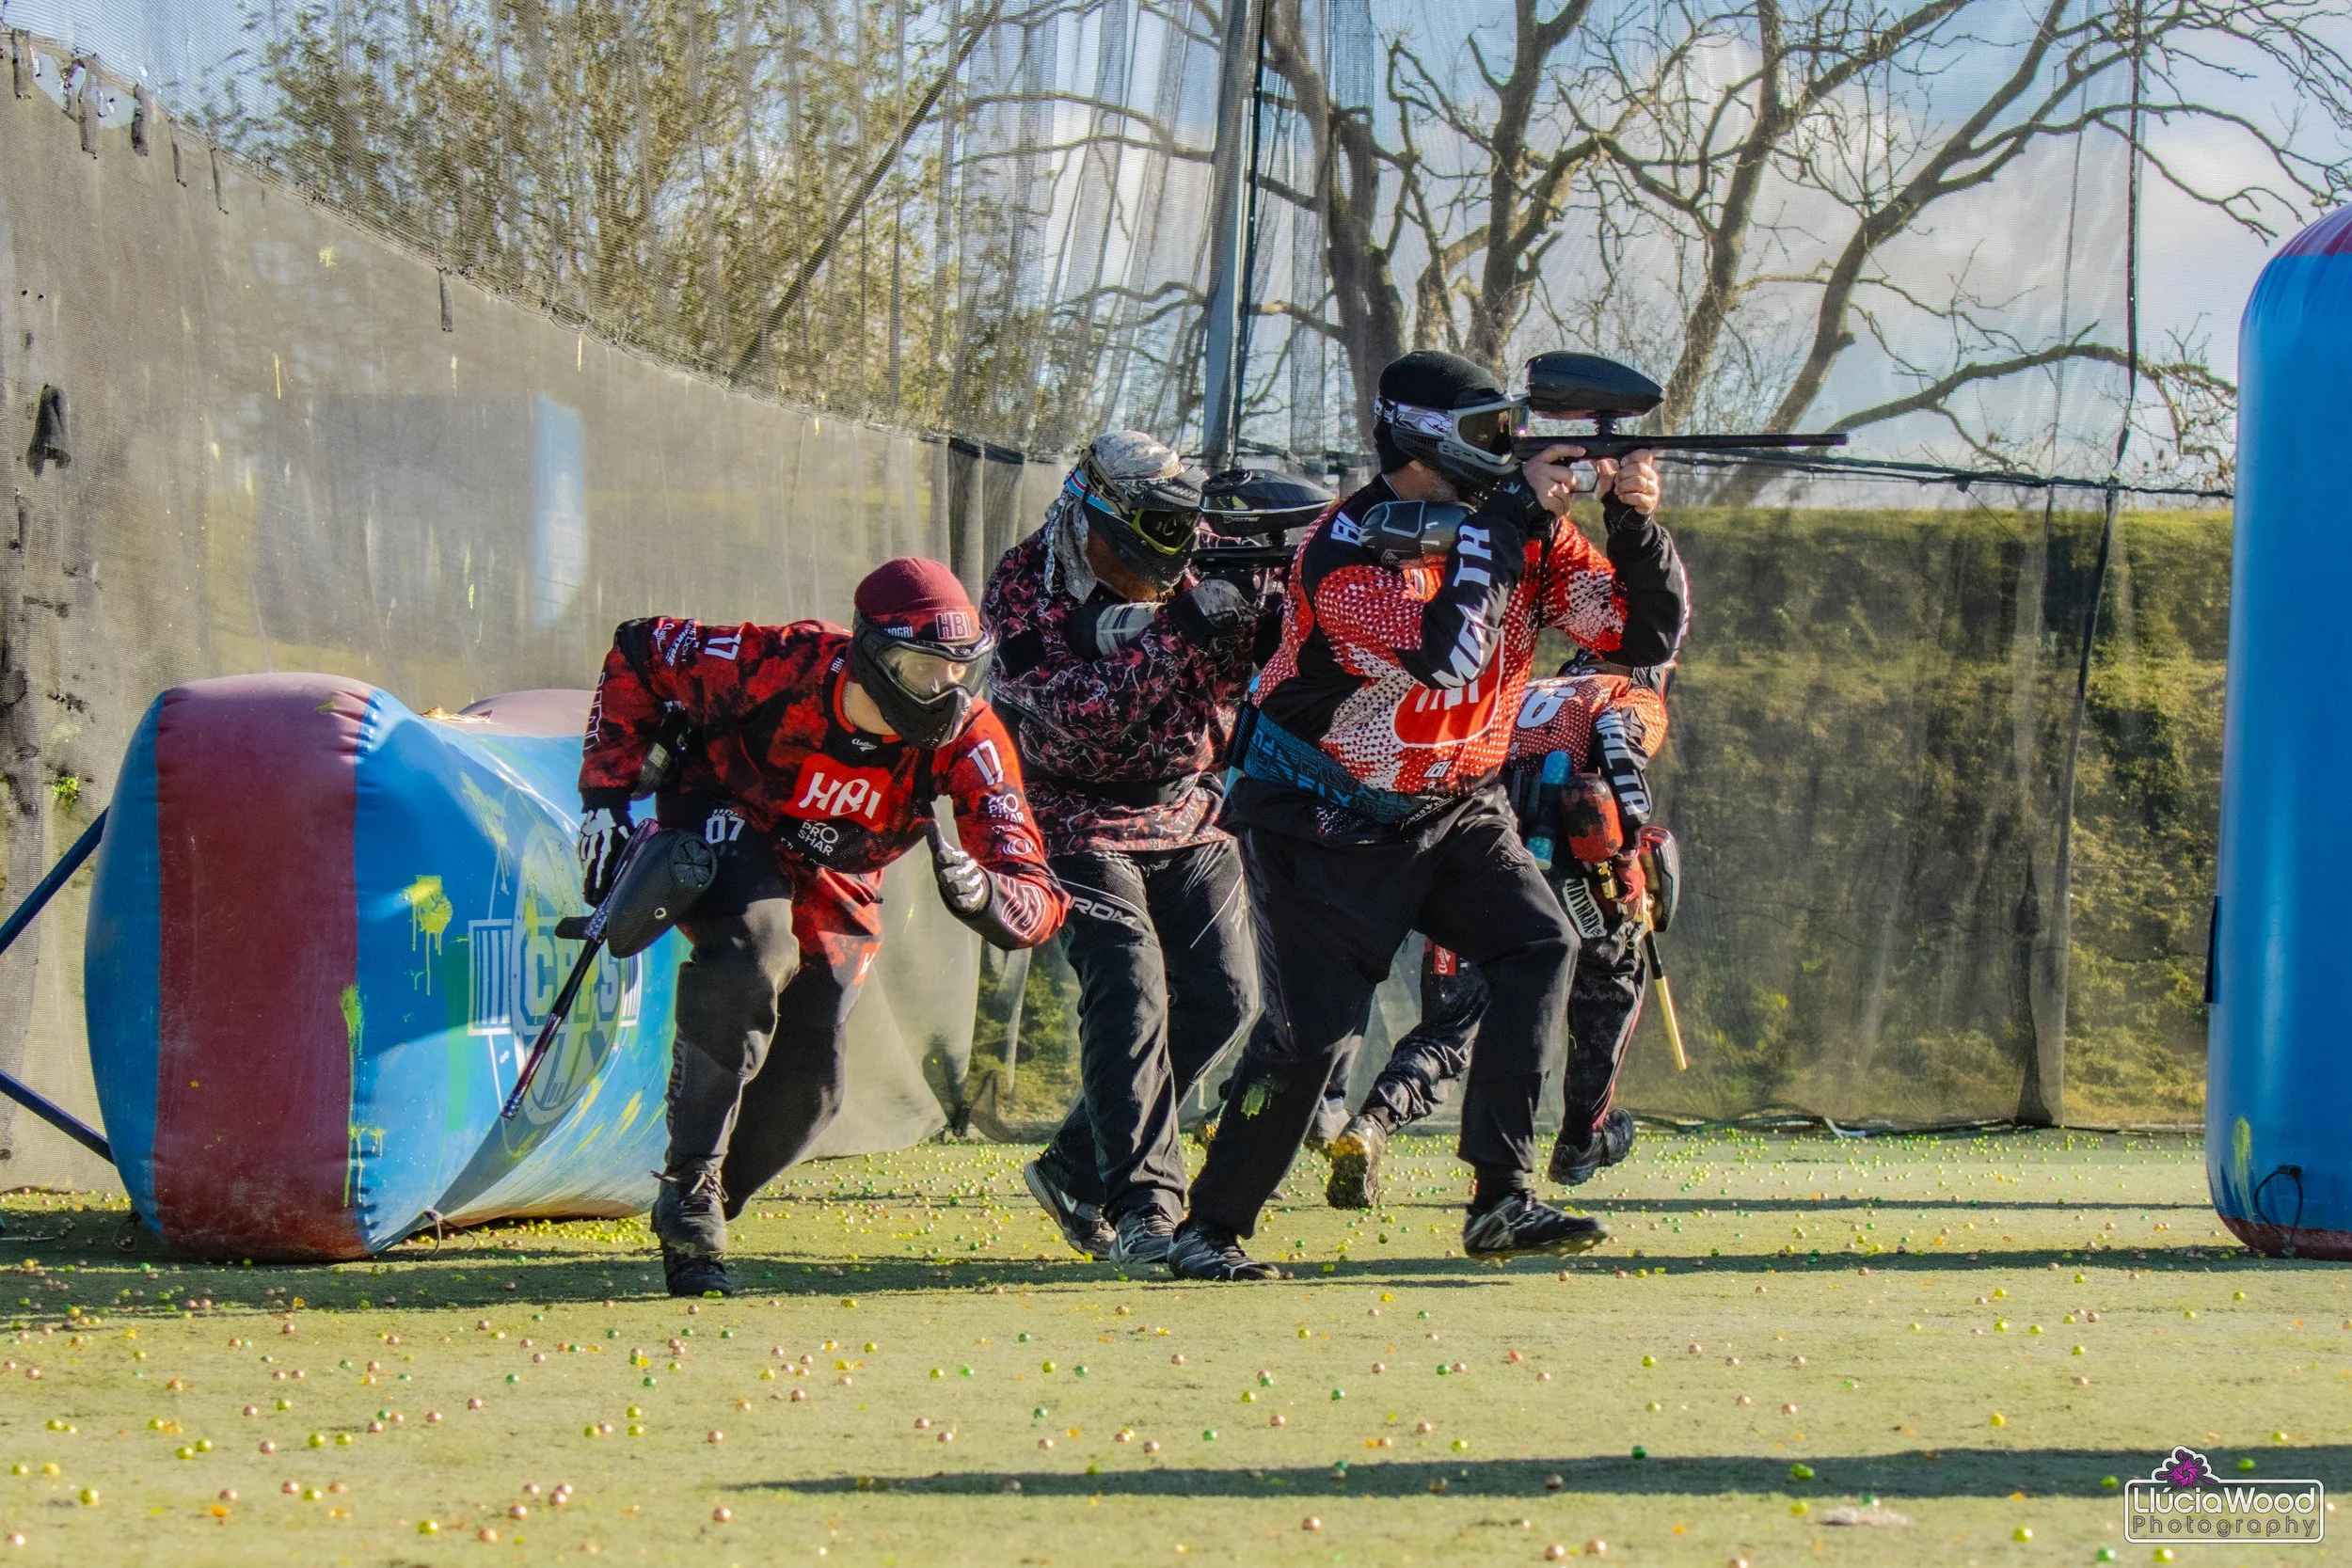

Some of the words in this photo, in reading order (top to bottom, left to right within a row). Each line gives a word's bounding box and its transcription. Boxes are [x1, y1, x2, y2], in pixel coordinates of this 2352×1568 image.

[935, 612, 971, 639] HBI
[967, 739, 1004, 786] 17
[798, 771, 882, 820] HBI
[706, 815, 746, 845] 07
[797, 829, 834, 857] SHAR
[801, 821, 839, 844] PRO
